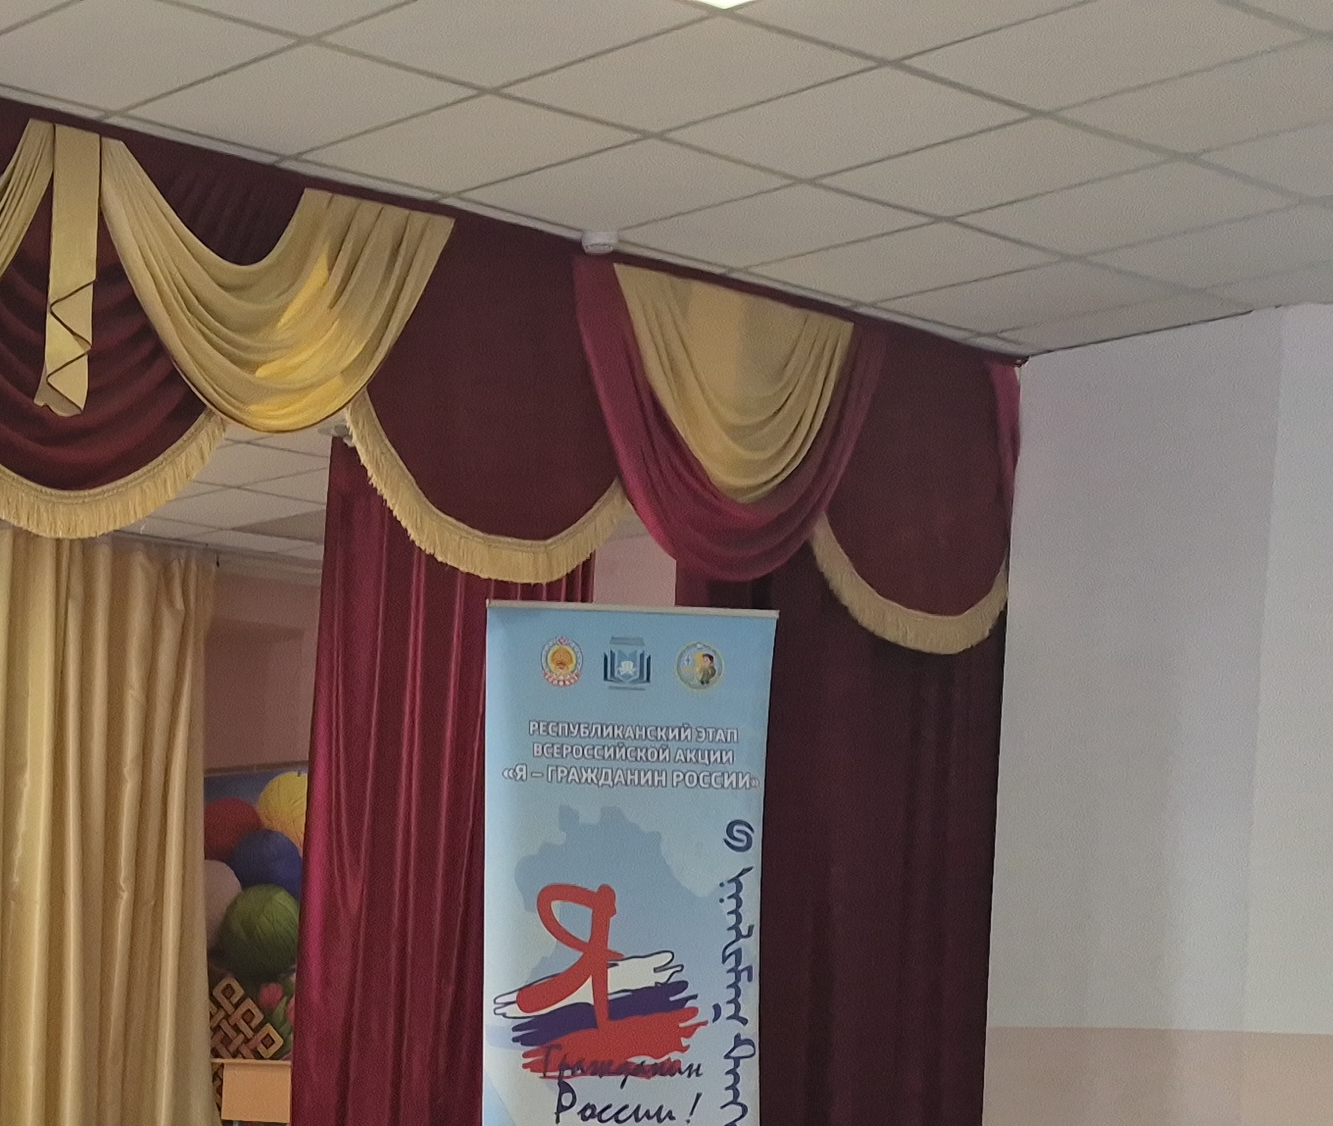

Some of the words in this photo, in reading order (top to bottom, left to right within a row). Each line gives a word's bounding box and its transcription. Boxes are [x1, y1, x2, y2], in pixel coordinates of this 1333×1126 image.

[528, 720, 693, 742] РЕСПУБЛИКАНСКИЙ
[696, 727, 738, 743] ЭТАП
[533, 742, 670, 763] ВСЕРОССИЙСКОЙ
[675, 749, 735, 766] АКЦИИ
[502, 763, 528, 781] «Я
[547, 766, 667, 788] ГРАЖДАНИН
[672, 770, 760, 790] РОССИИ»
[516, 883, 625, 1030] Я
